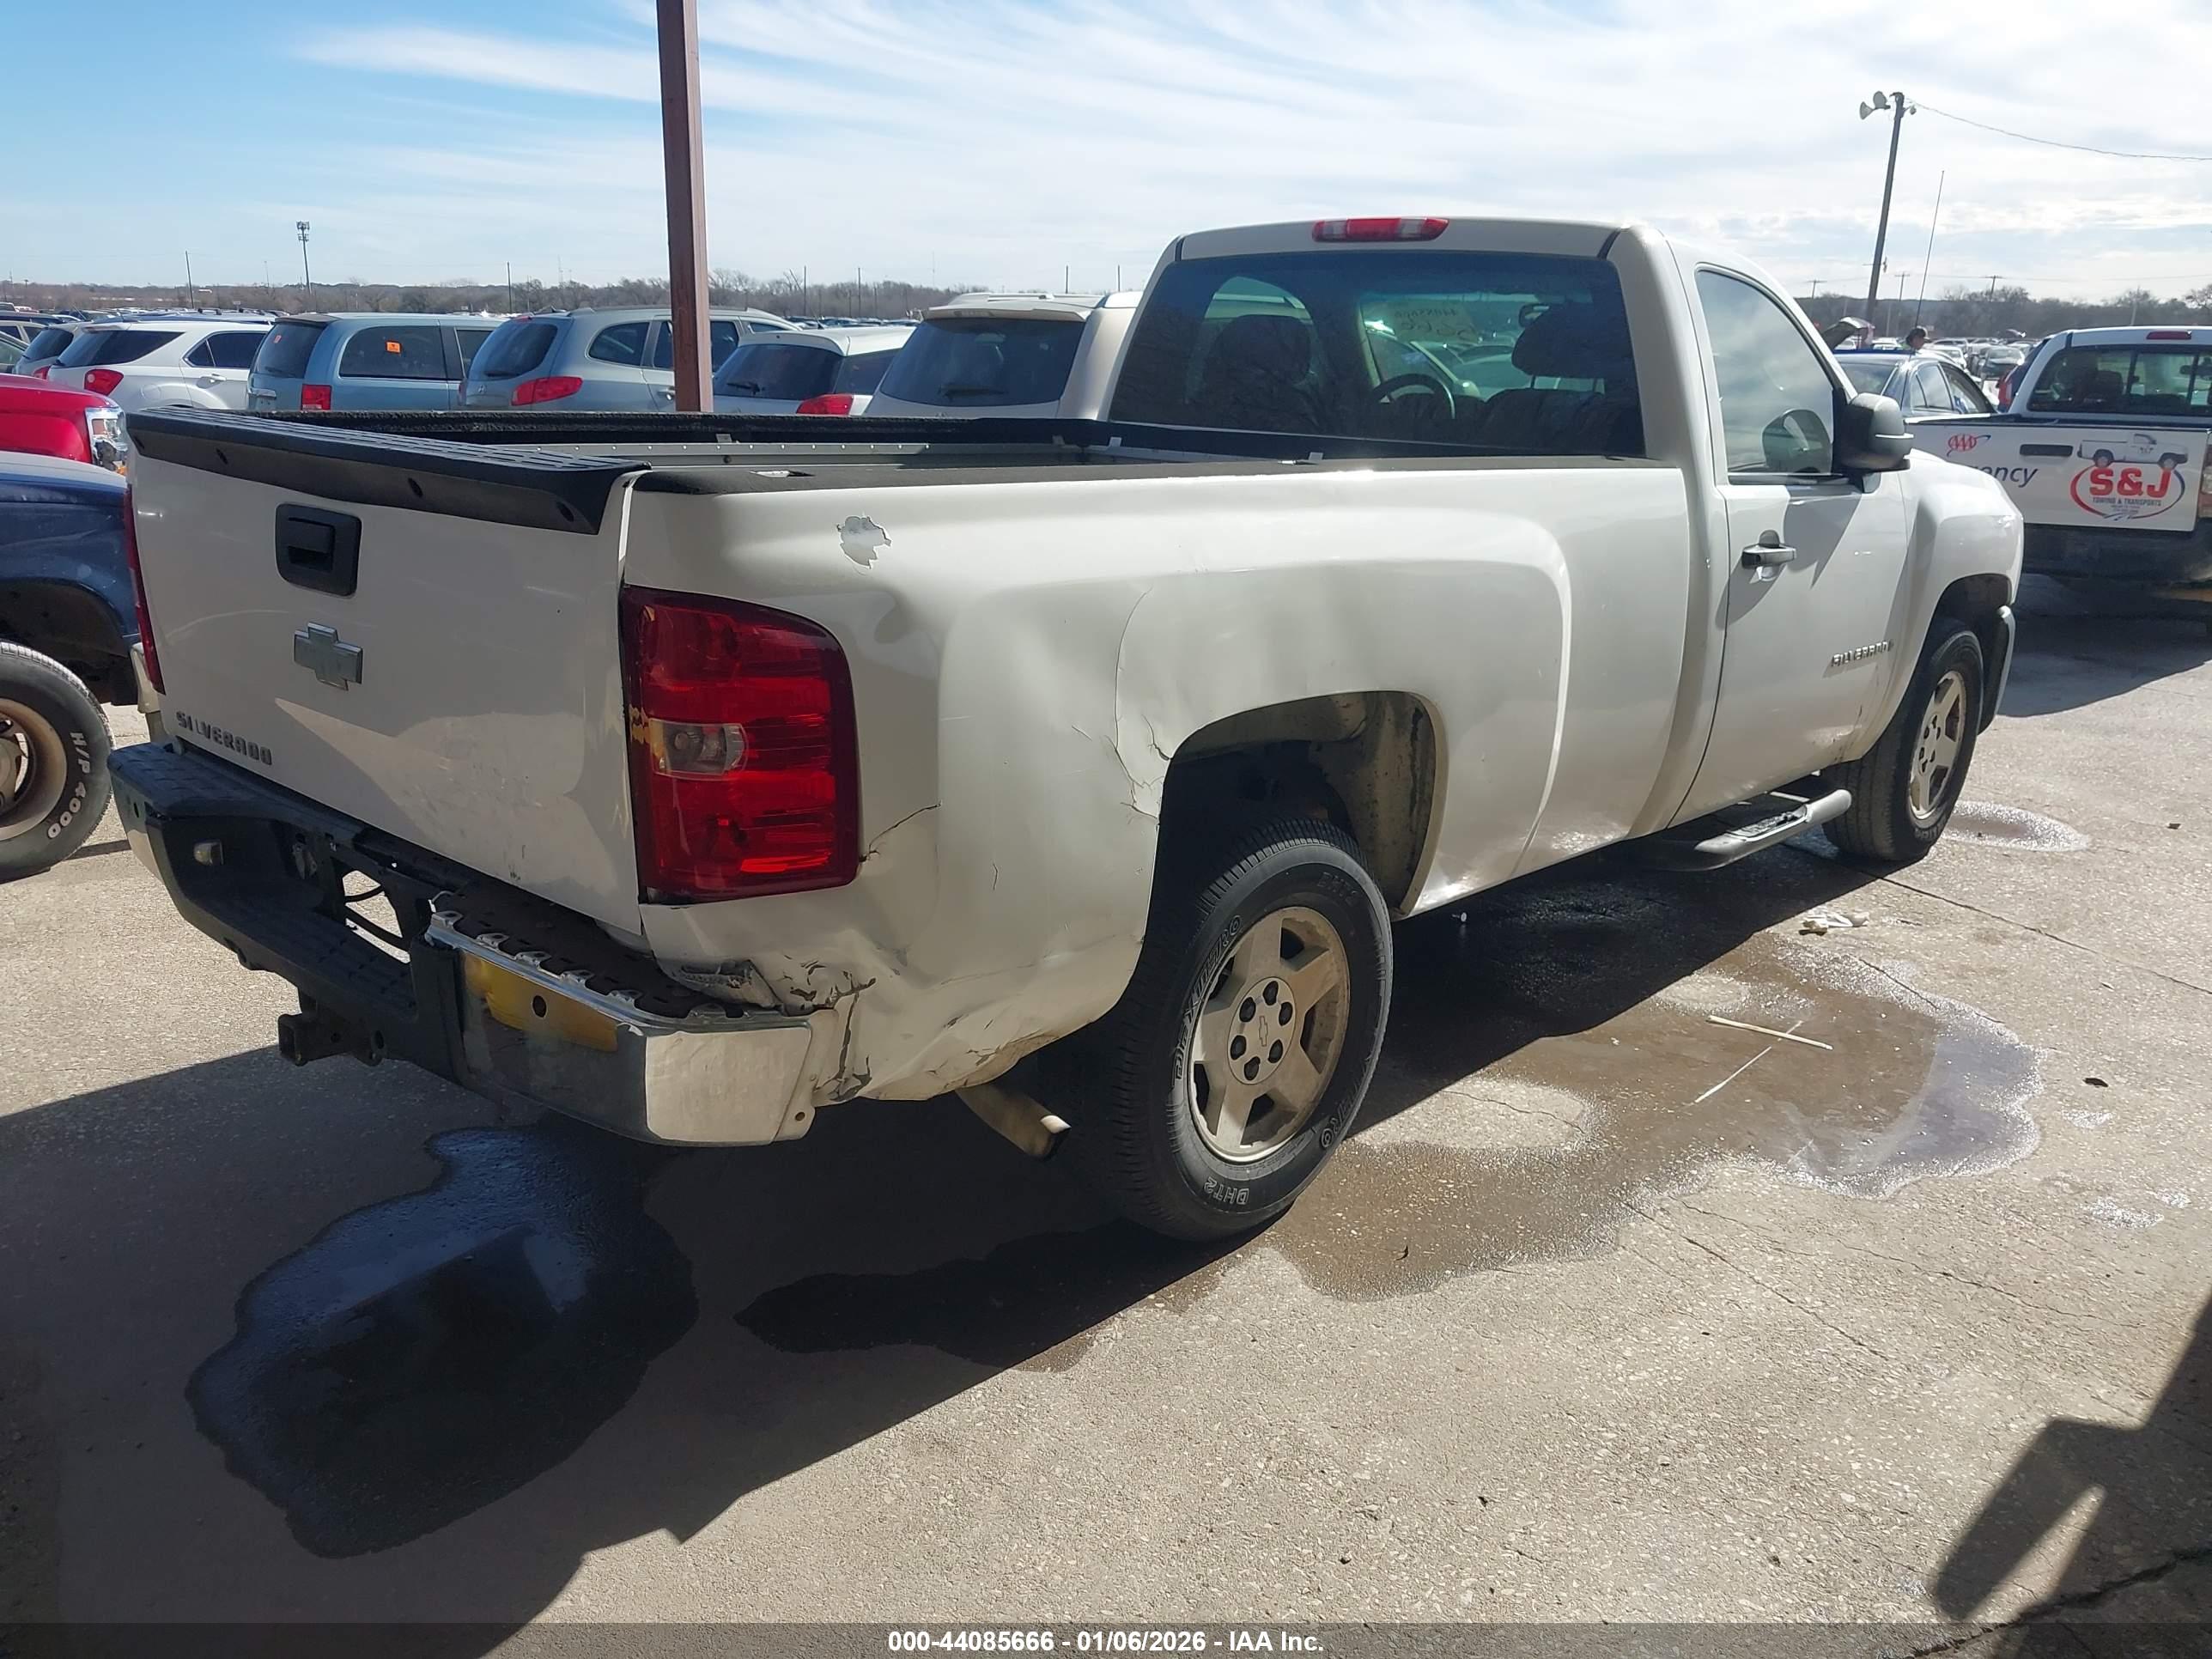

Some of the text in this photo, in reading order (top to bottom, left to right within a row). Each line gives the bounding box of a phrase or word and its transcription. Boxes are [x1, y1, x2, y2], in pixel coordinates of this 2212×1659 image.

[1948, 434, 1977, 452] AAA
[1972, 466, 2038, 488] ency
[2089, 467, 2171, 498] S&J
[70, 732, 90, 774] H/P
[176, 711, 272, 765] SILVERADO
[47, 781, 86, 839] 4000
[1202, 1176, 1249, 1206] DHT2
